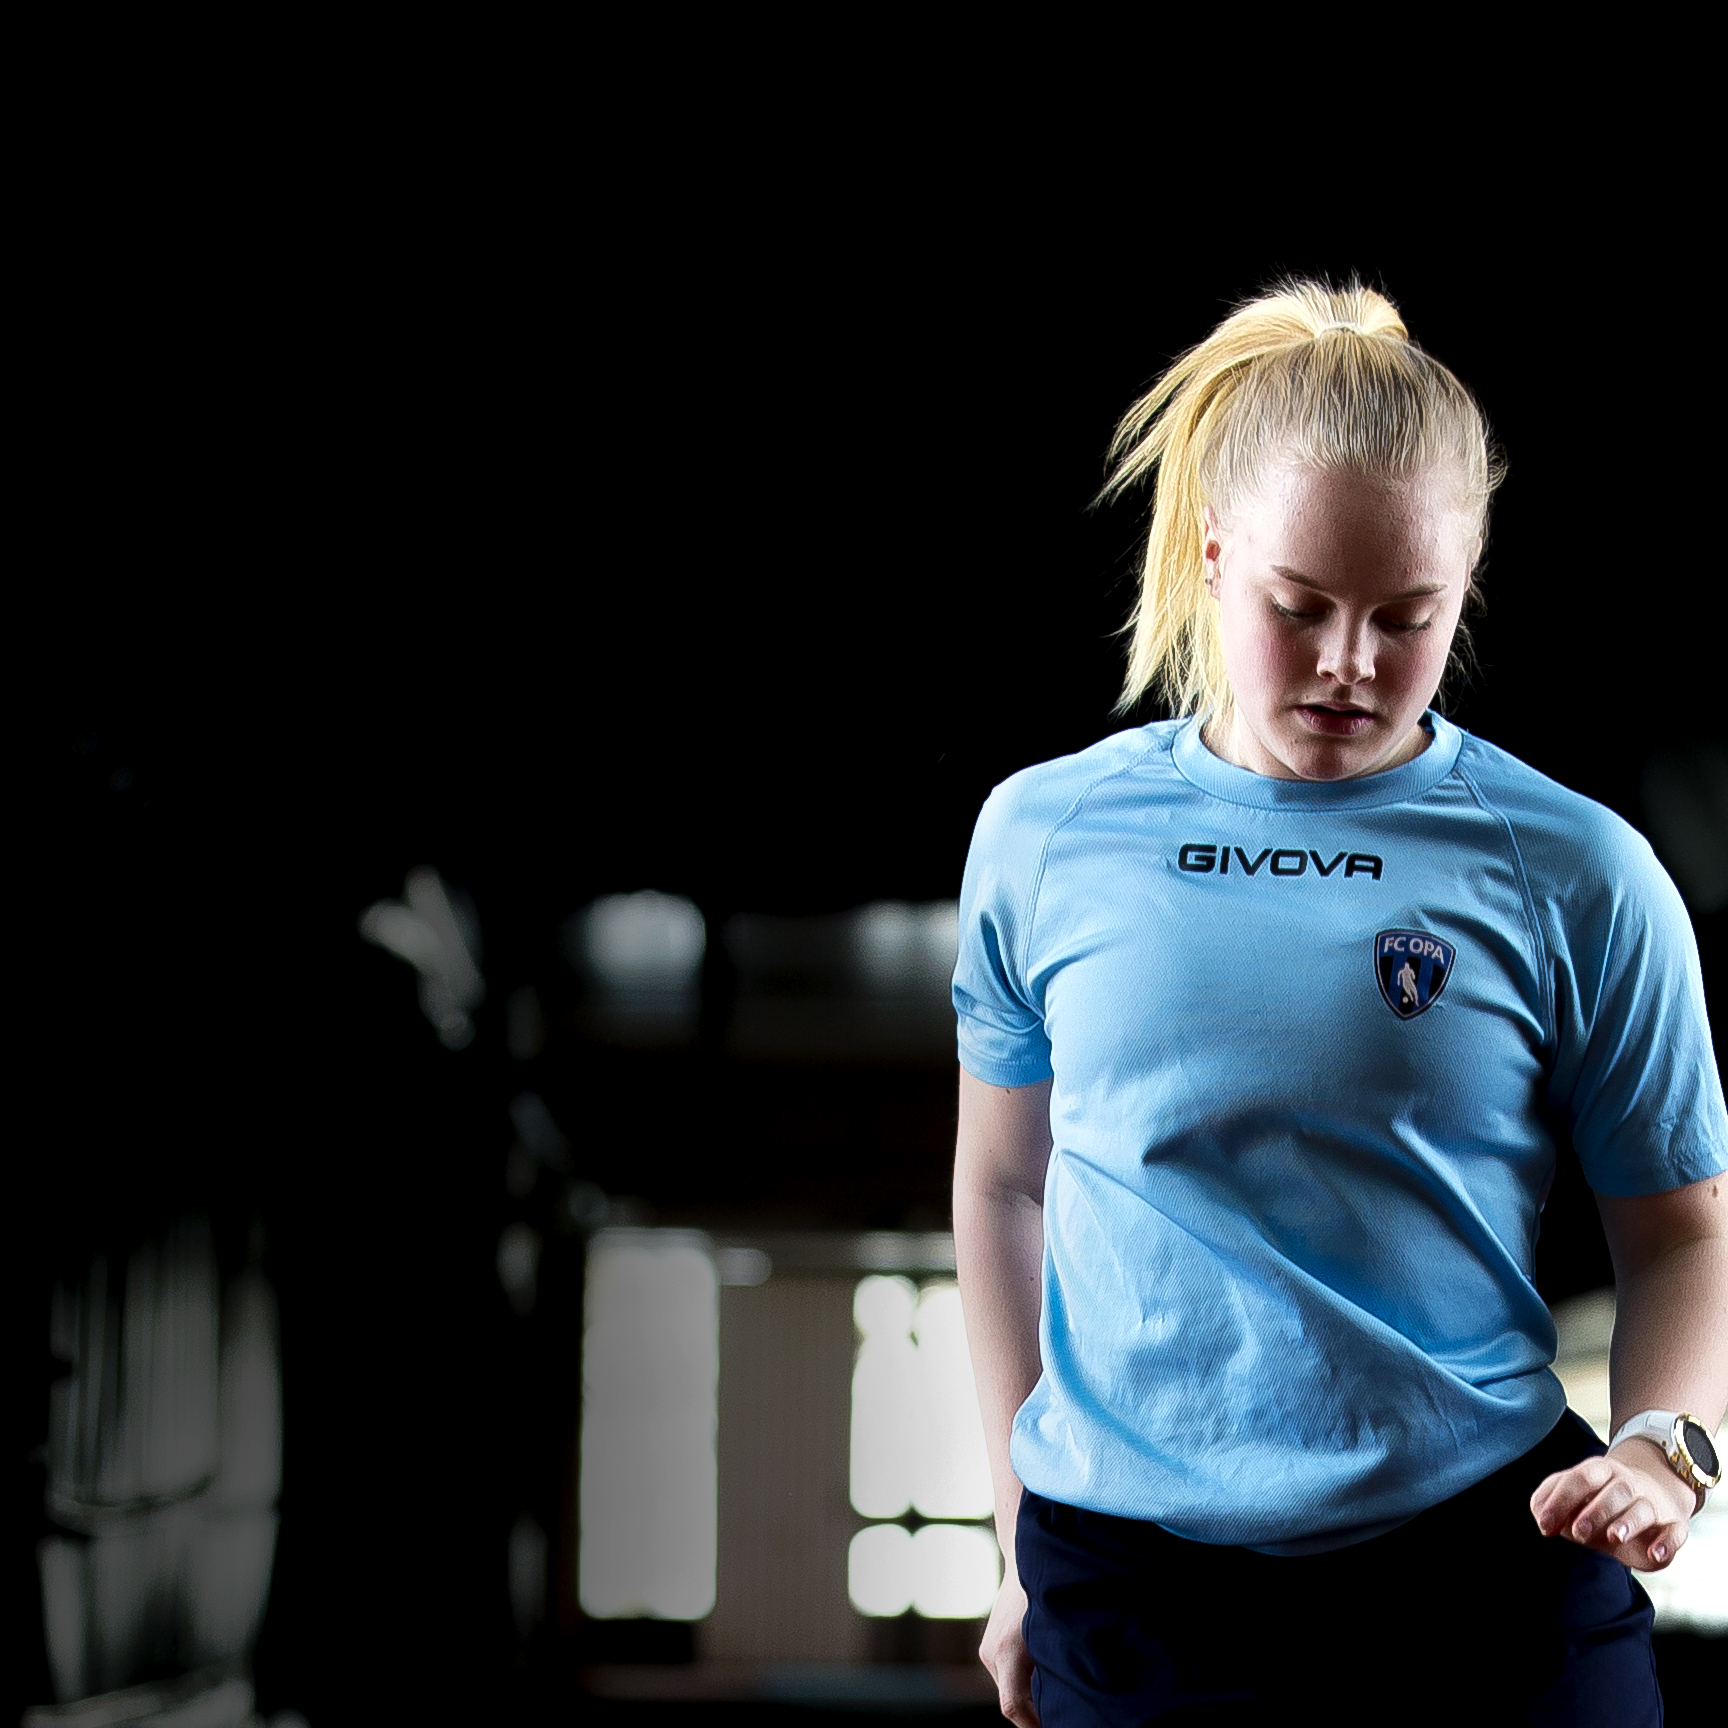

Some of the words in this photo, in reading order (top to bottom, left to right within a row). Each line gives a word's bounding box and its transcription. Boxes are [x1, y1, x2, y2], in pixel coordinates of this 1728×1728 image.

[1177, 843, 1384, 881] GIVOVA
[1383, 935, 1407, 954] FC
[1408, 937, 1446, 965] OPA
